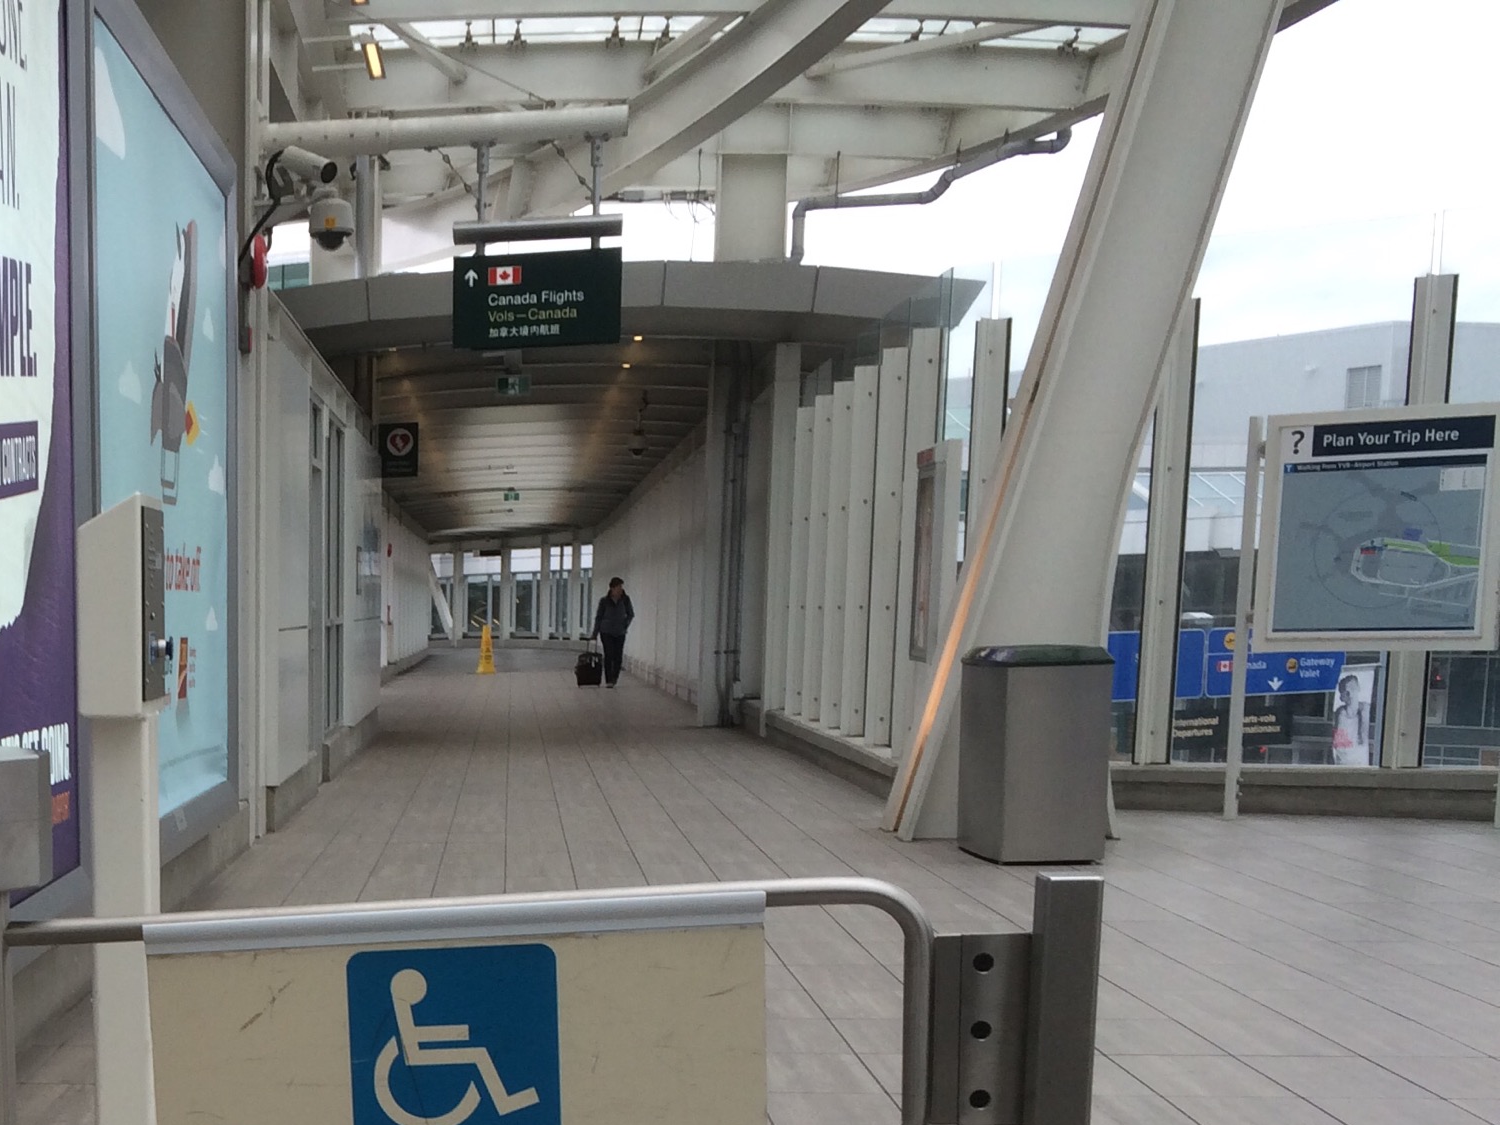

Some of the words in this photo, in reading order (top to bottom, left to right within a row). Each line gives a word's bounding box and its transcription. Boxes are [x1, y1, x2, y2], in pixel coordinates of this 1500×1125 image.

[488, 292, 537, 306] Canada
[541, 289, 585, 305] Flights
[1323, 433, 1354, 448] Plan
[1358, 431, 1390, 446] Your
[1393, 429, 1421, 446] Trip
[1424, 428, 1460, 442] Here
[1244, 660, 1267, 670] nada
[1300, 657, 1335, 669] Gateway
[1300, 668, 1320, 679] Valet
